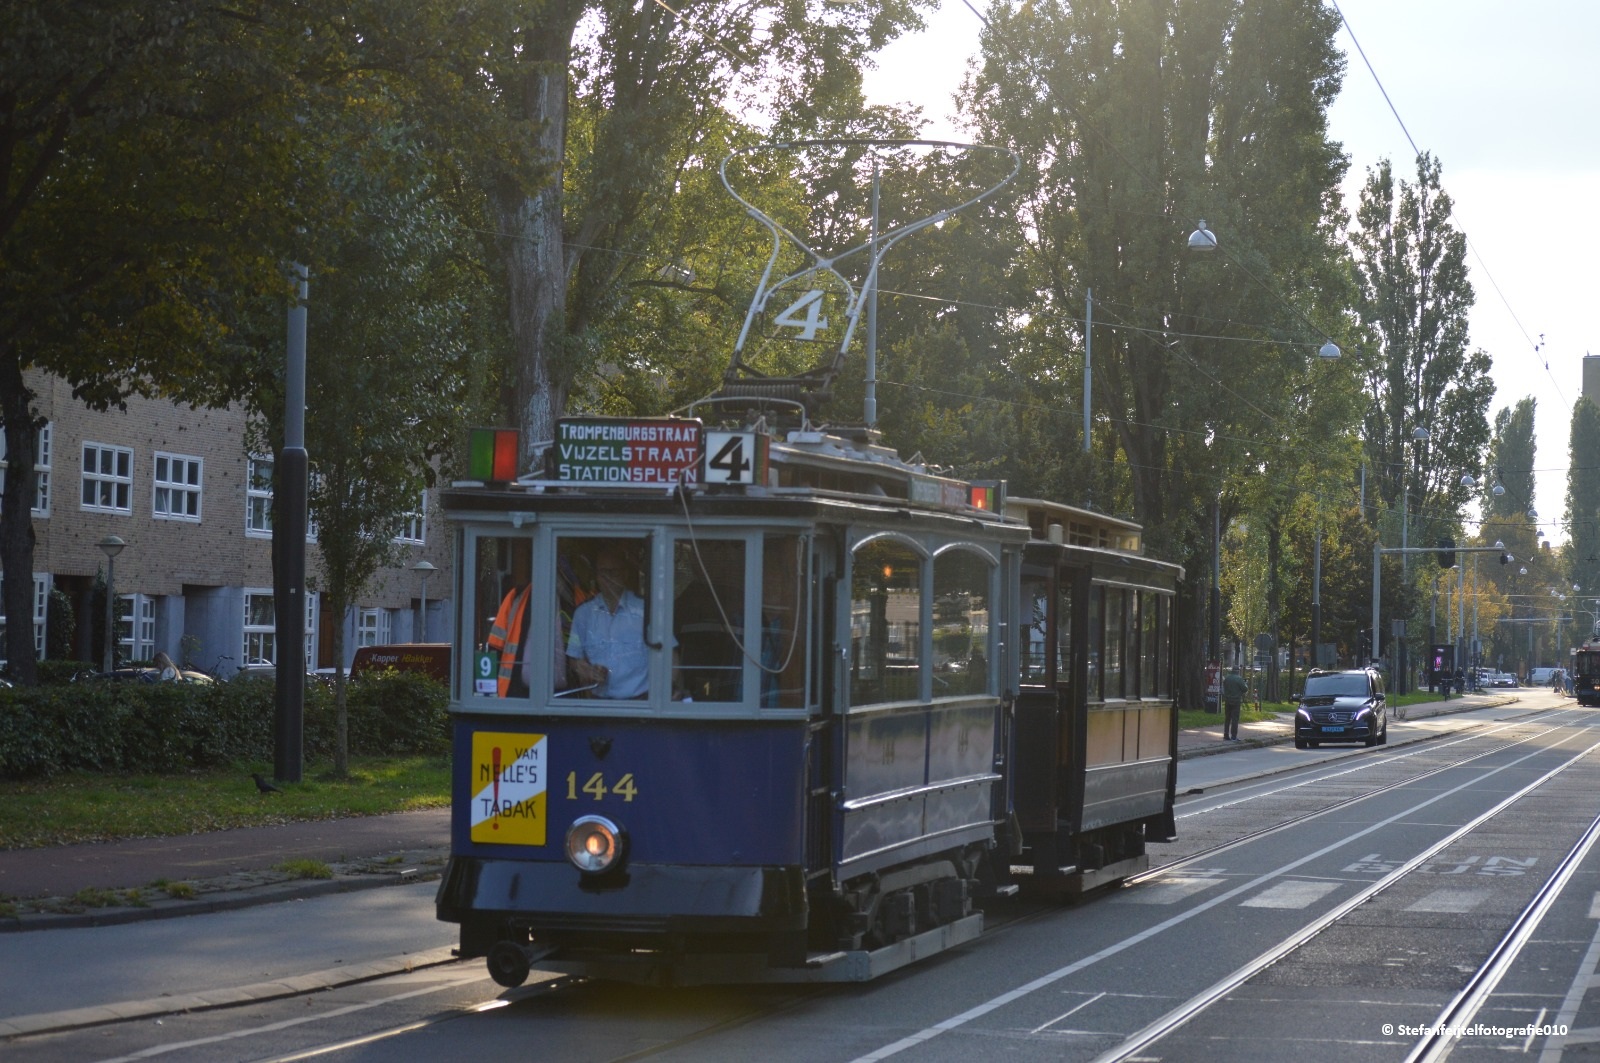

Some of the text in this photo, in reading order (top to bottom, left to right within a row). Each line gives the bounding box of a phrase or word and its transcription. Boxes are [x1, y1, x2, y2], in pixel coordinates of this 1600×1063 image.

[774, 290, 828, 340] 4
[560, 424, 697, 442] TROMPENBURGSTRAAT
[560, 443, 697, 462] VIJZELSTRAAT
[708, 436, 750, 481] 4
[559, 464, 697, 483] STATIONSPLEN
[480, 656, 491, 677] 9
[515, 748, 538, 760] VAN
[480, 764, 537, 783] NELLE'S
[566, 771, 638, 802] 144
[480, 799, 536, 819] TABAK
[1340, 863, 1526, 876] BUS
